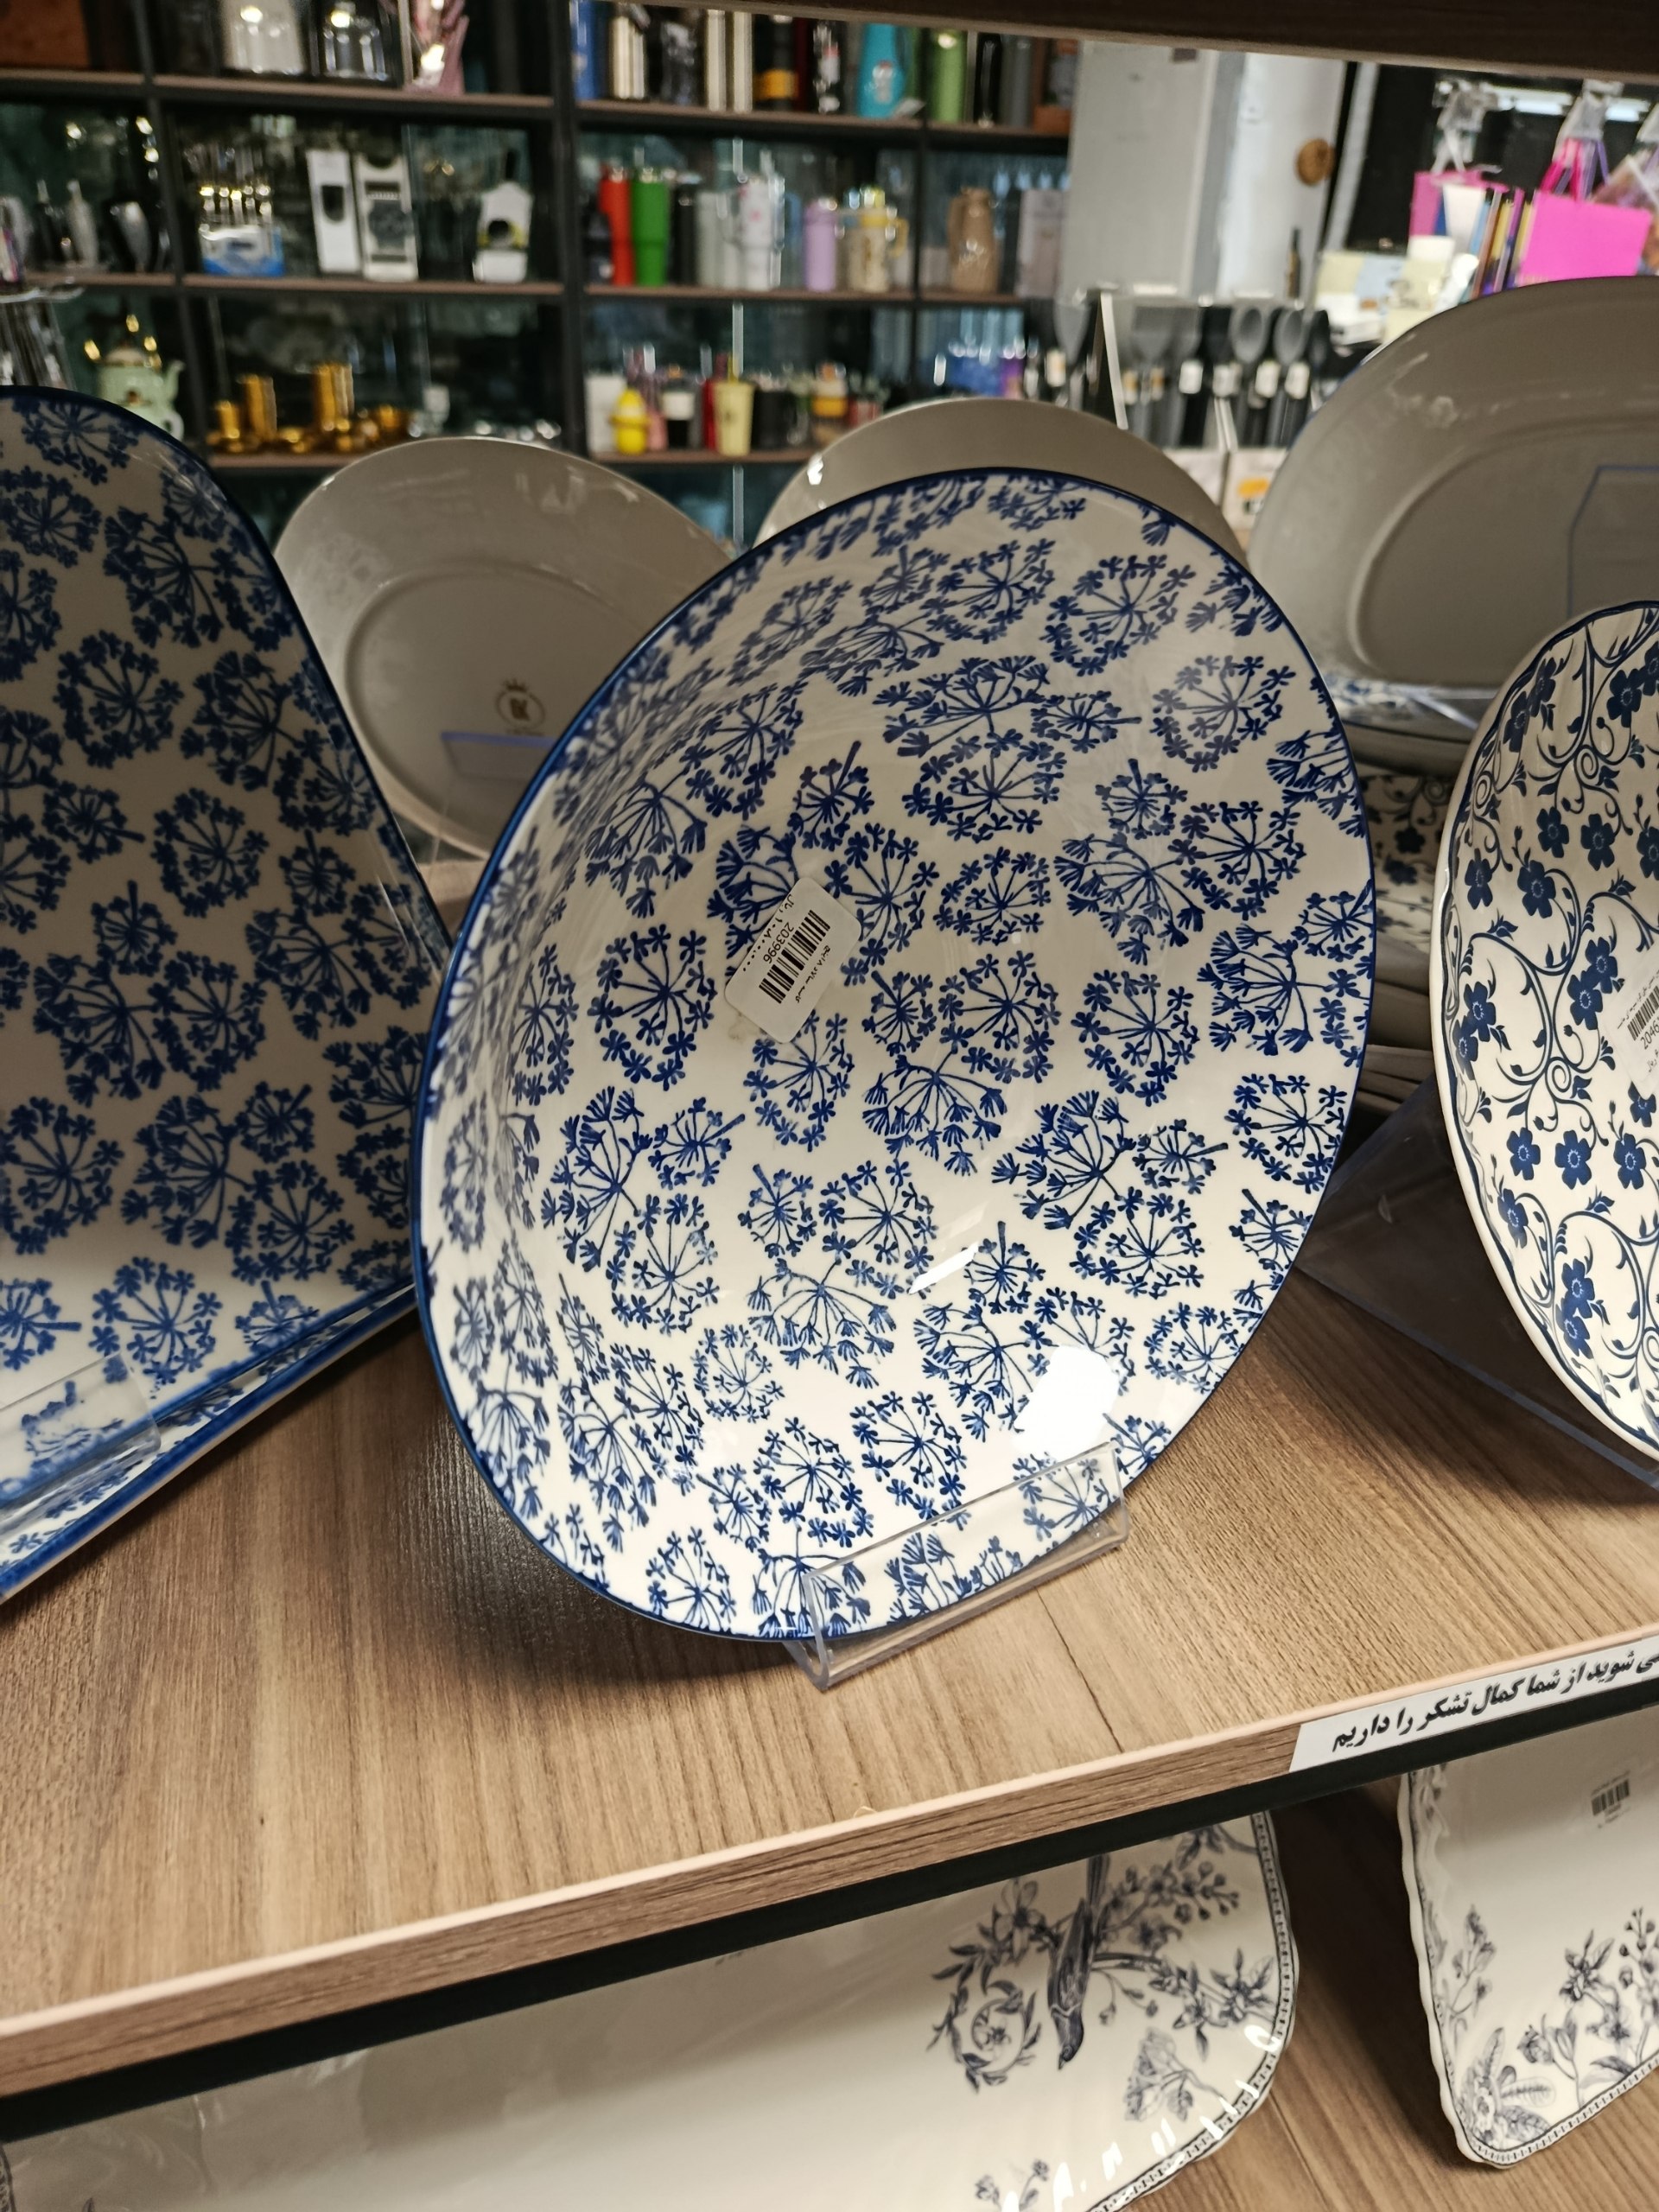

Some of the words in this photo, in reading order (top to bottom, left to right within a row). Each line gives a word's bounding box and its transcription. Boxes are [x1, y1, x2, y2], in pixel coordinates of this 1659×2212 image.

[763, 922, 794, 963] 203996
[805, 967, 818, 984] سالاد
[1640, 1016, 1659, 1051] 2046
[1526, 1669, 1560, 1696] شما
[1560, 1661, 1587, 1694] از
[1587, 1650, 1635, 1682] شوید
[1416, 1692, 1471, 1732] تشکر
[1471, 1676, 1526, 1715] کمال
[1332, 1714, 1390, 1752] داریم
[1396, 1707, 1414, 1736] را
